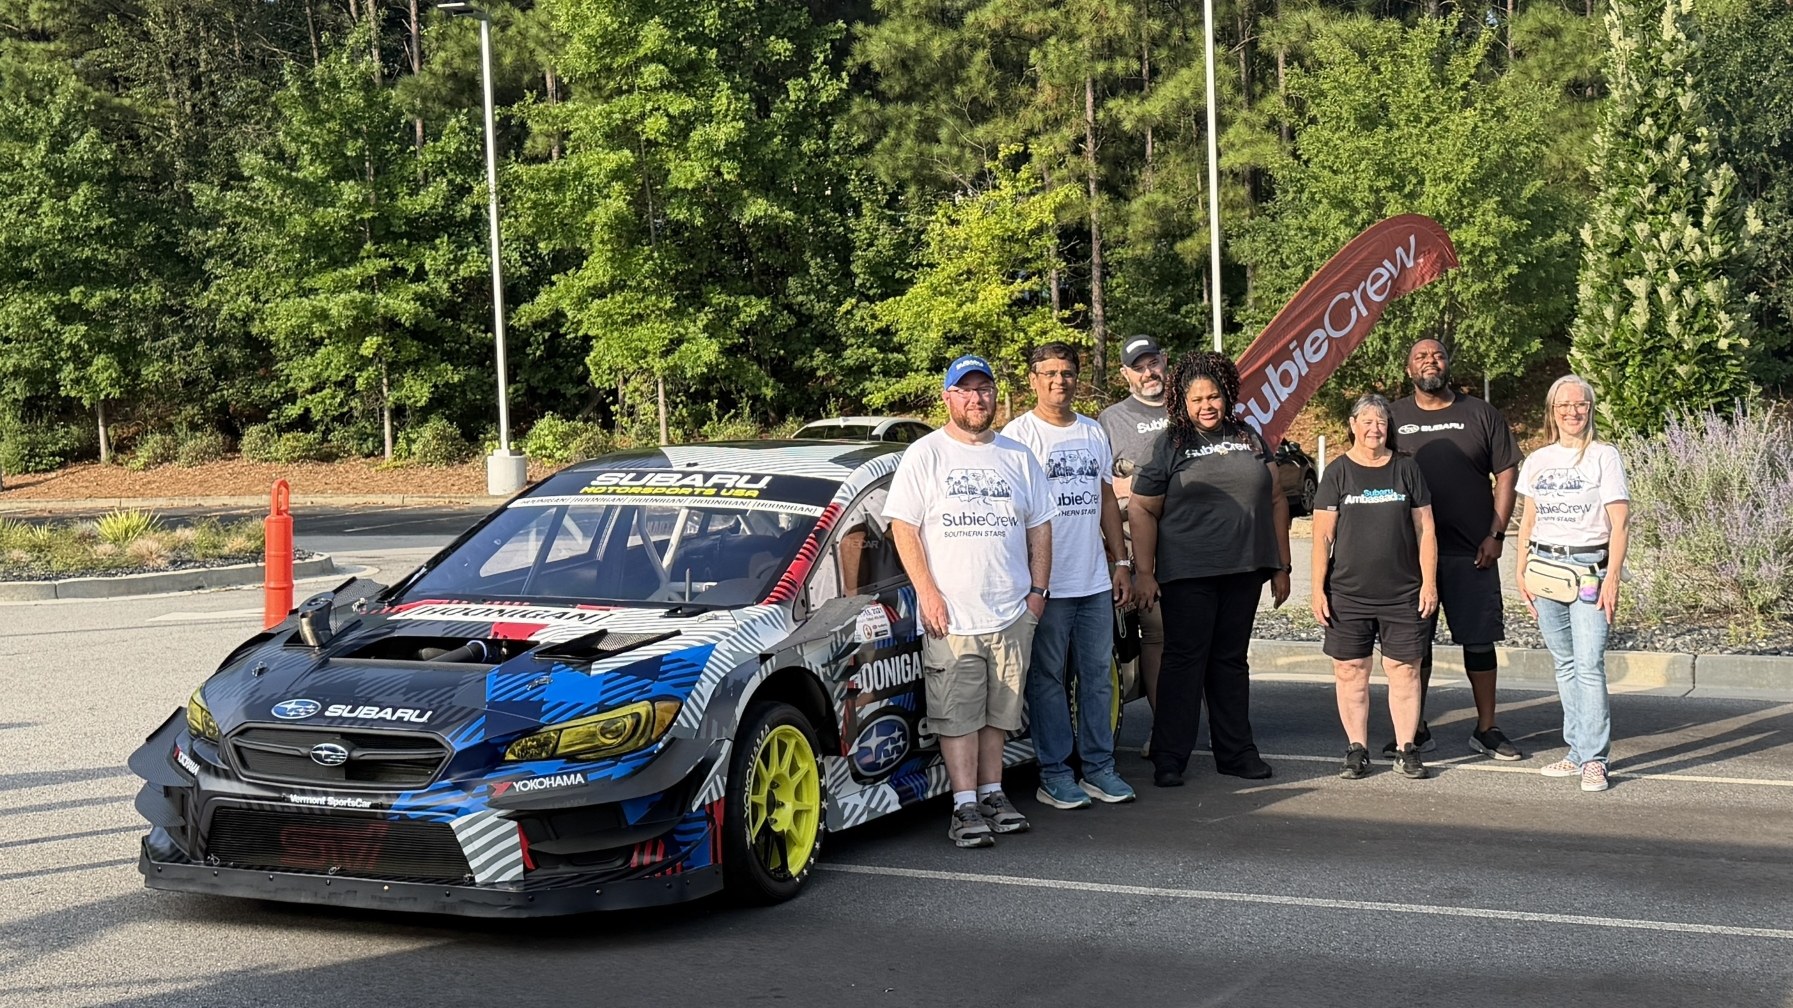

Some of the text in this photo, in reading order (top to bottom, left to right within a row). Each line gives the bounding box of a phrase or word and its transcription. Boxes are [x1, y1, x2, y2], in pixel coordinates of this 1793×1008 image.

[1137, 418, 1171, 434] Subie
[1421, 422, 1465, 432] SUBARU
[591, 473, 773, 489] SUBARU
[580, 486, 760, 498] MOTORSPORTS USA
[1363, 488, 1394, 498] Subaru
[1536, 502, 1592, 515] bieCrew
[942, 511, 1019, 527] SubieCrew
[944, 530, 1006, 538] SOUTHERN STARS
[849, 650, 924, 693] OONIGA
[324, 704, 433, 723] SUBARU
[512, 773, 585, 792] YOKOHAMA
[289, 794, 372, 808] Vermont SportsCar
